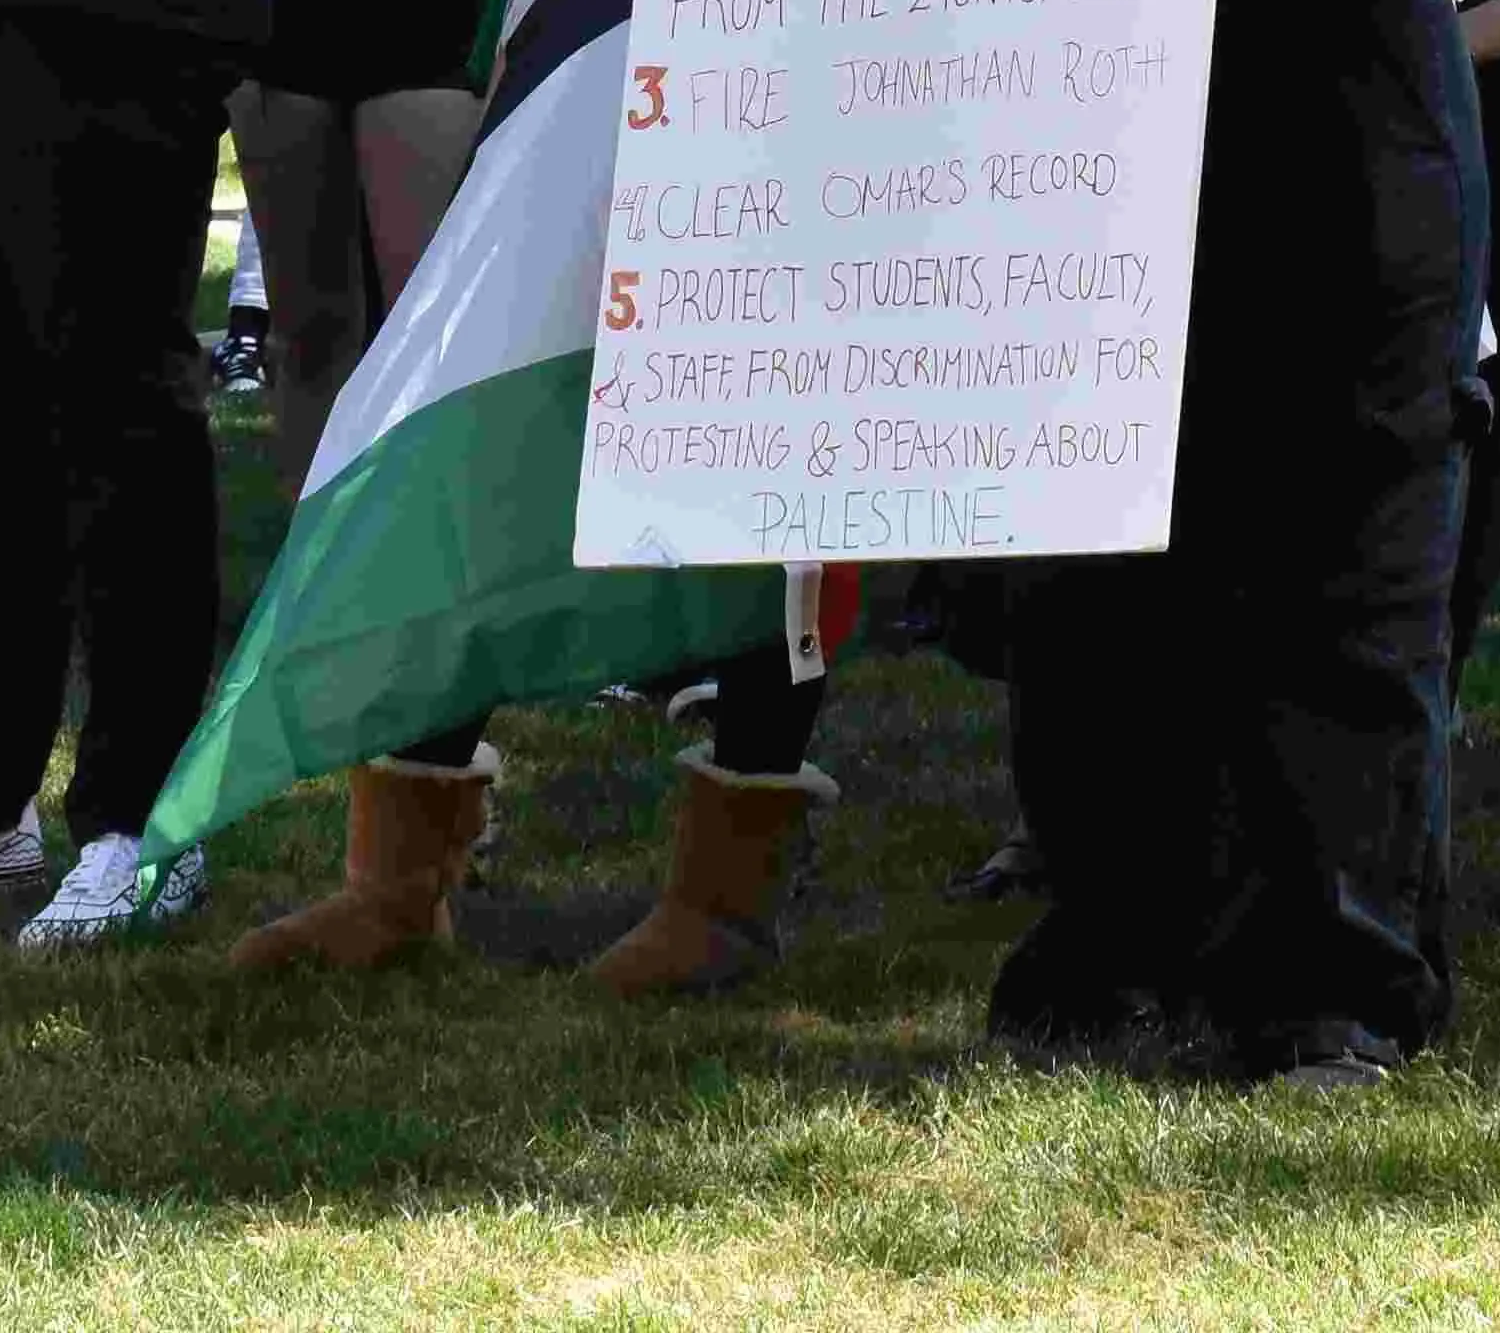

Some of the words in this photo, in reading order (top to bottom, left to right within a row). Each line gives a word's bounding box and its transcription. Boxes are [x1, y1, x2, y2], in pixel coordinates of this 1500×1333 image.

[627, 66, 670, 130] 3.
[690, 67, 789, 134] FIRE
[832, 47, 1037, 116] JOHNATHAN
[1062, 39, 1170, 103] ROTH
[658, 178, 790, 239] CLEAR
[822, 158, 968, 218] OMAR'S
[981, 152, 1117, 202] RECORD
[605, 271, 644, 331] 5.
[655, 266, 804, 332] PROTECT
[825, 255, 993, 318] STUDENTS,
[1002, 251, 1154, 319] FACULTY,
[746, 348, 832, 399] FROM
[844, 340, 1078, 395] DISCRIMINATION
[1094, 337, 1162, 386] FOR
[593, 421, 791, 478] PROTESTING
[807, 420, 843, 477] &
[853, 418, 1017, 472] SPEAKING
[1033, 421, 1152, 469] ABOUT
[752, 486, 1015, 553] PALESTINE.
